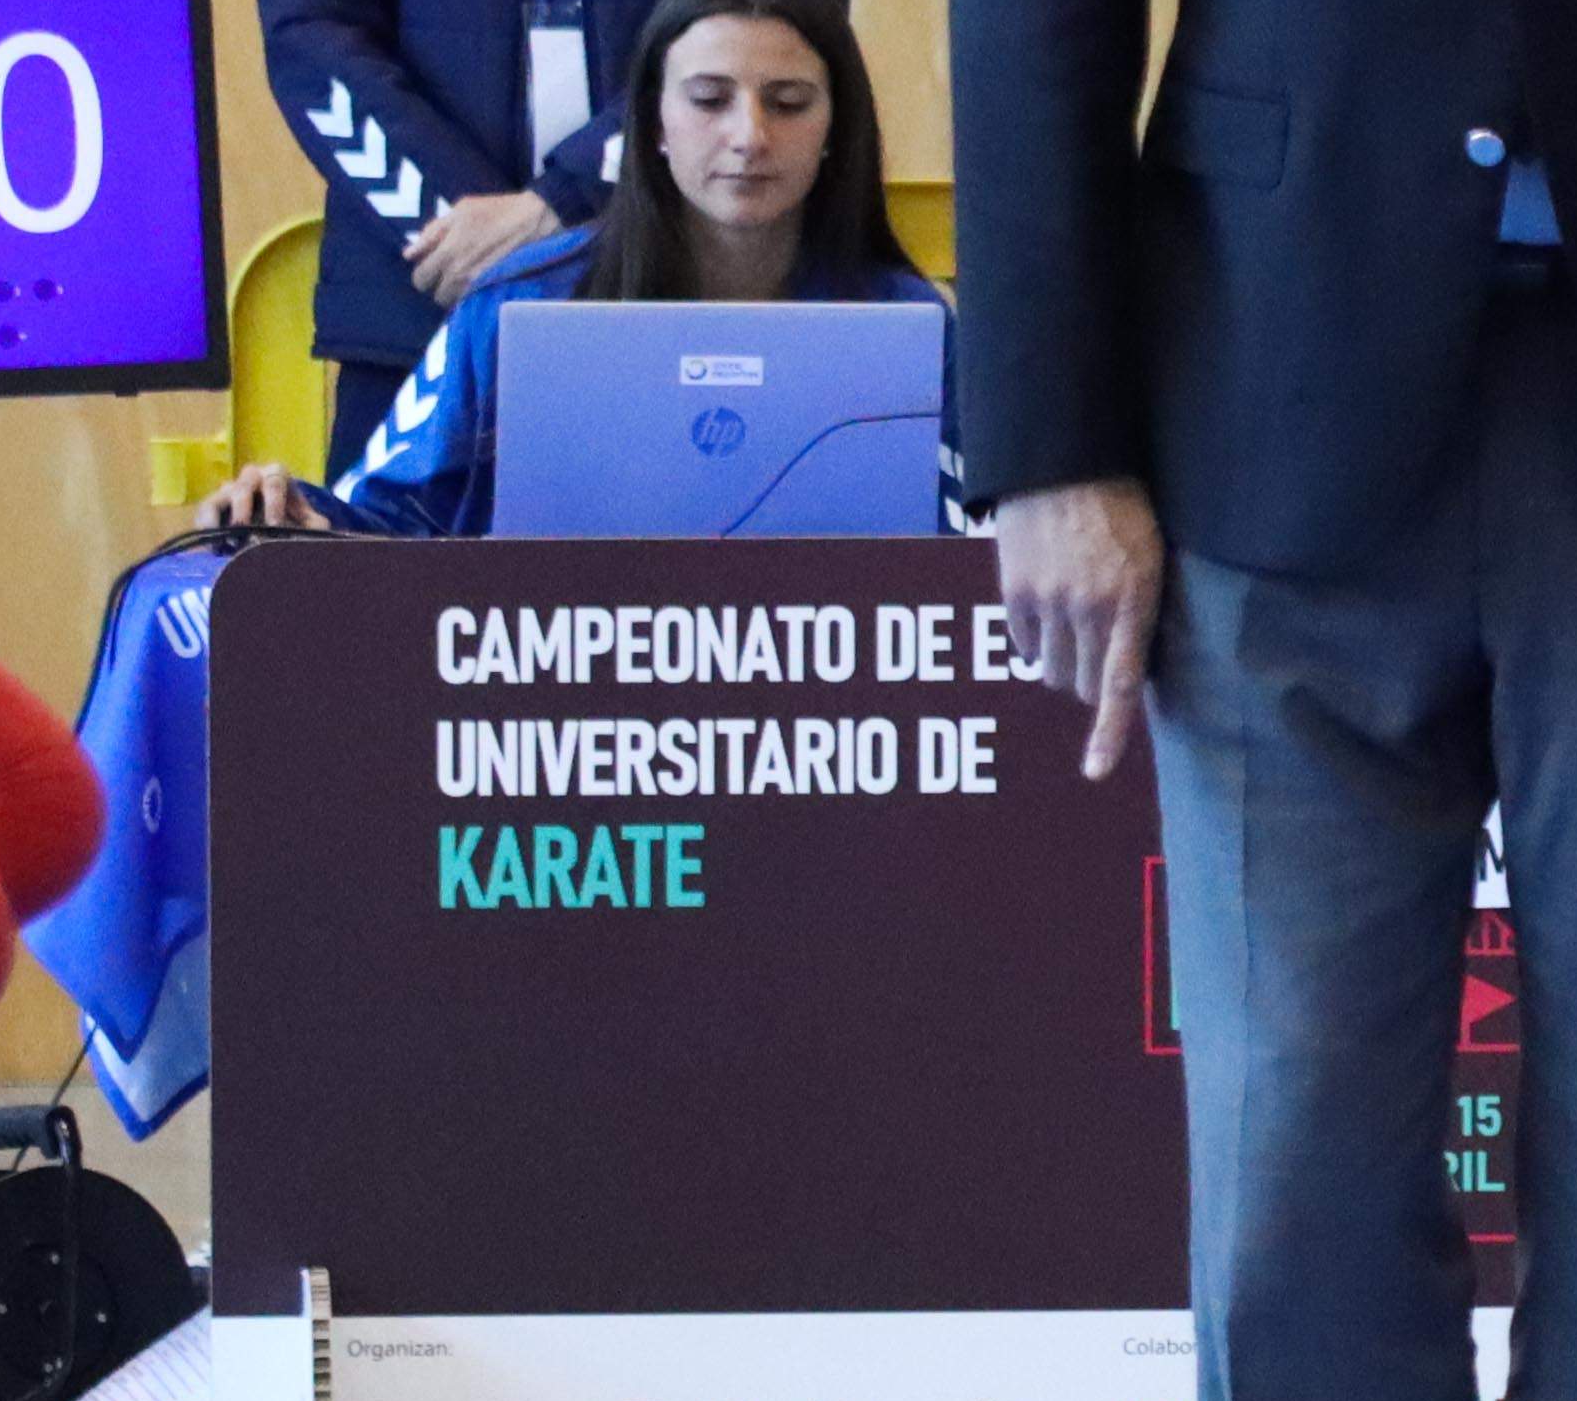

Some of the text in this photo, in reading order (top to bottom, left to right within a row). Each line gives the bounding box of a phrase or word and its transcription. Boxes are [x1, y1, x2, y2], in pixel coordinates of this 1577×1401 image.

[436, 605, 856, 685] CAMPEONATO
[875, 605, 955, 683] DE
[435, 716, 997, 797] UNIVERSITARIO DE
[438, 824, 706, 910] KARATE
[1455, 1094, 1504, 1138] 15
